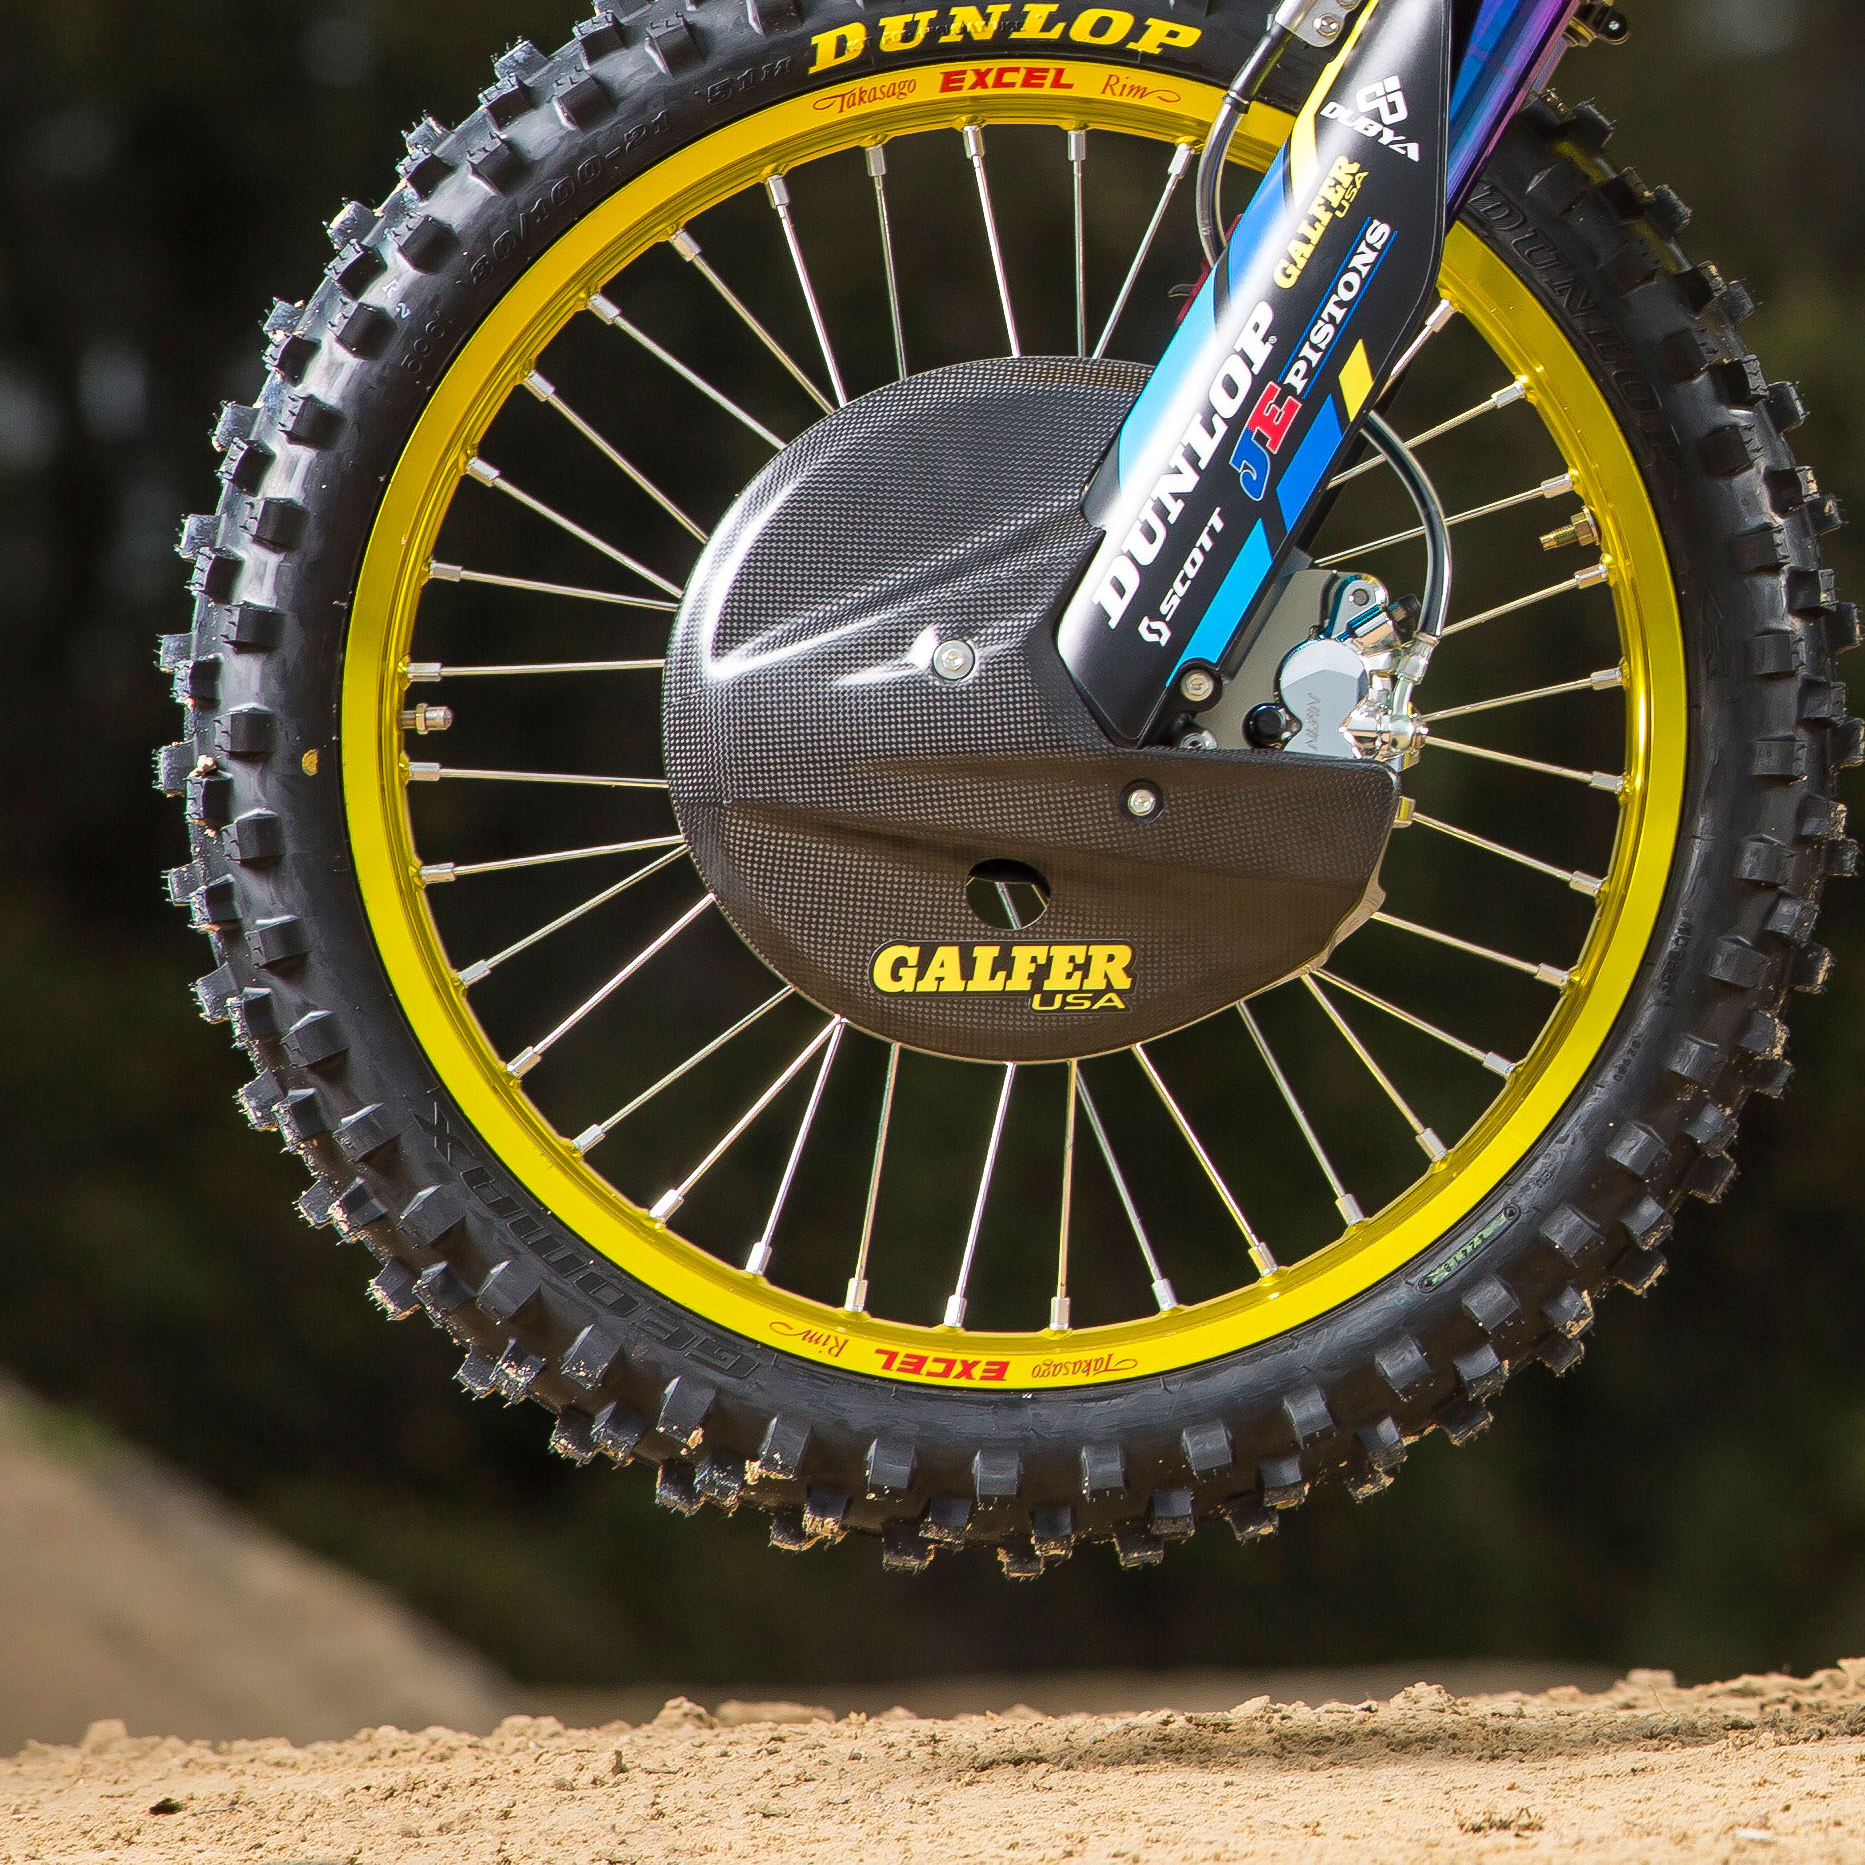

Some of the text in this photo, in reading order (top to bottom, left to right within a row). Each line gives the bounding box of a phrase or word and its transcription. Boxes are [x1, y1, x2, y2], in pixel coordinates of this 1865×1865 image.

[807, 3, 1204, 76] DUNLOP
[812, 66, 1184, 117] Takasago EXCEL Rim
[1318, 101, 1421, 162] DUBYA
[470, 109, 672, 286] 80/100-21
[1272, 156, 1360, 290] GALFER
[1334, 171, 1368, 218] USA
[1230, 219, 1391, 502] JE PISTONS
[1092, 301, 1274, 629] DUNLOP
[1158, 508, 1225, 619] SCOTT
[870, 942, 1136, 995] GALFER
[1031, 992, 1129, 1012] USA
[428, 1101, 760, 1380] GEOMAX
[767, 1319, 1138, 1383] Takasago EXCEL Rim
